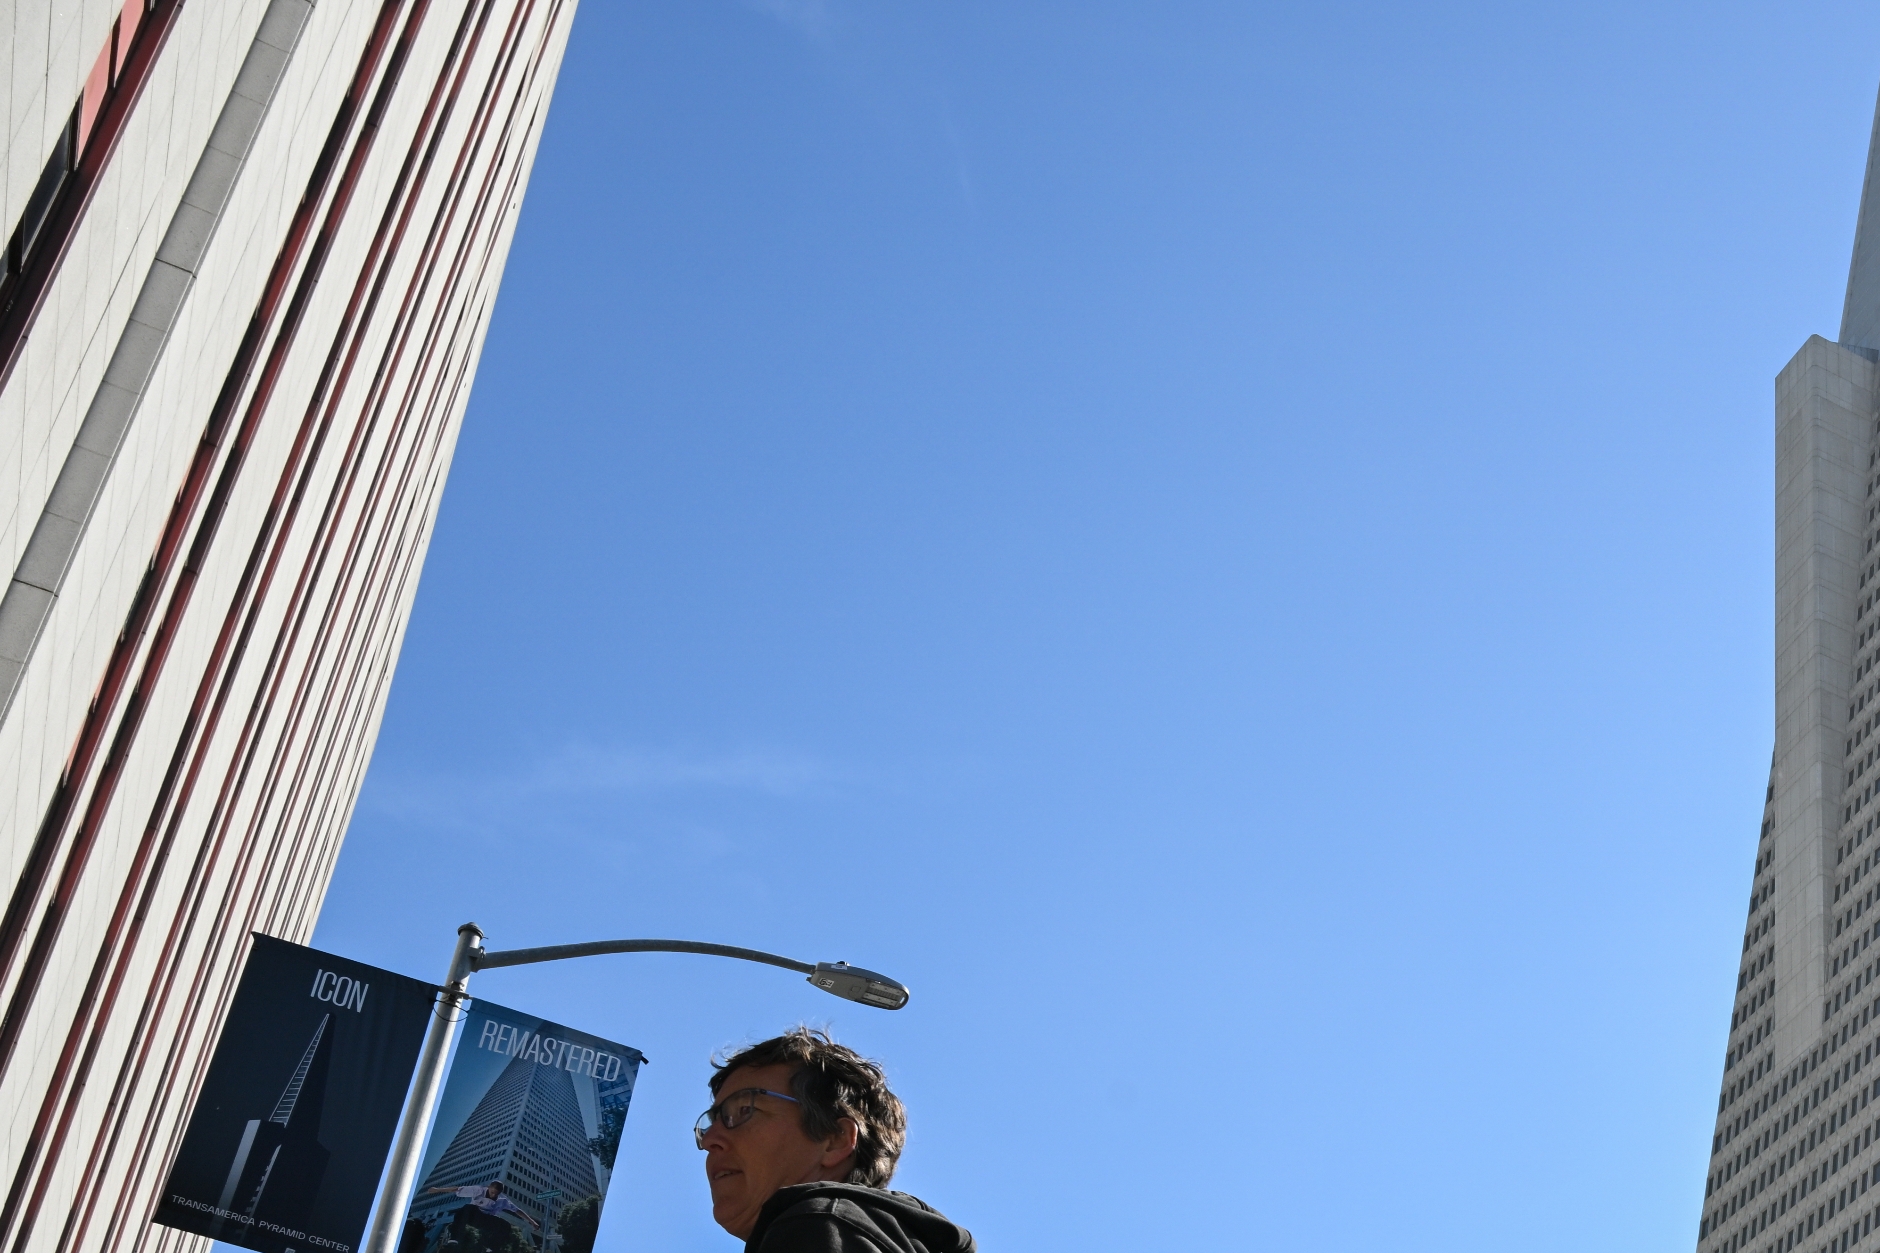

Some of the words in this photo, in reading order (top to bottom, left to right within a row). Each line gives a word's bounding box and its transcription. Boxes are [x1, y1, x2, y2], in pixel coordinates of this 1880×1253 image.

[310, 968, 369, 1013] ICON
[478, 1019, 622, 1082] REMASTERED
[172, 1194, 256, 1226] TRANSAMERICA
[258, 1220, 306, 1241] PYRAMID
[308, 1236, 350, 1253] CENTER
